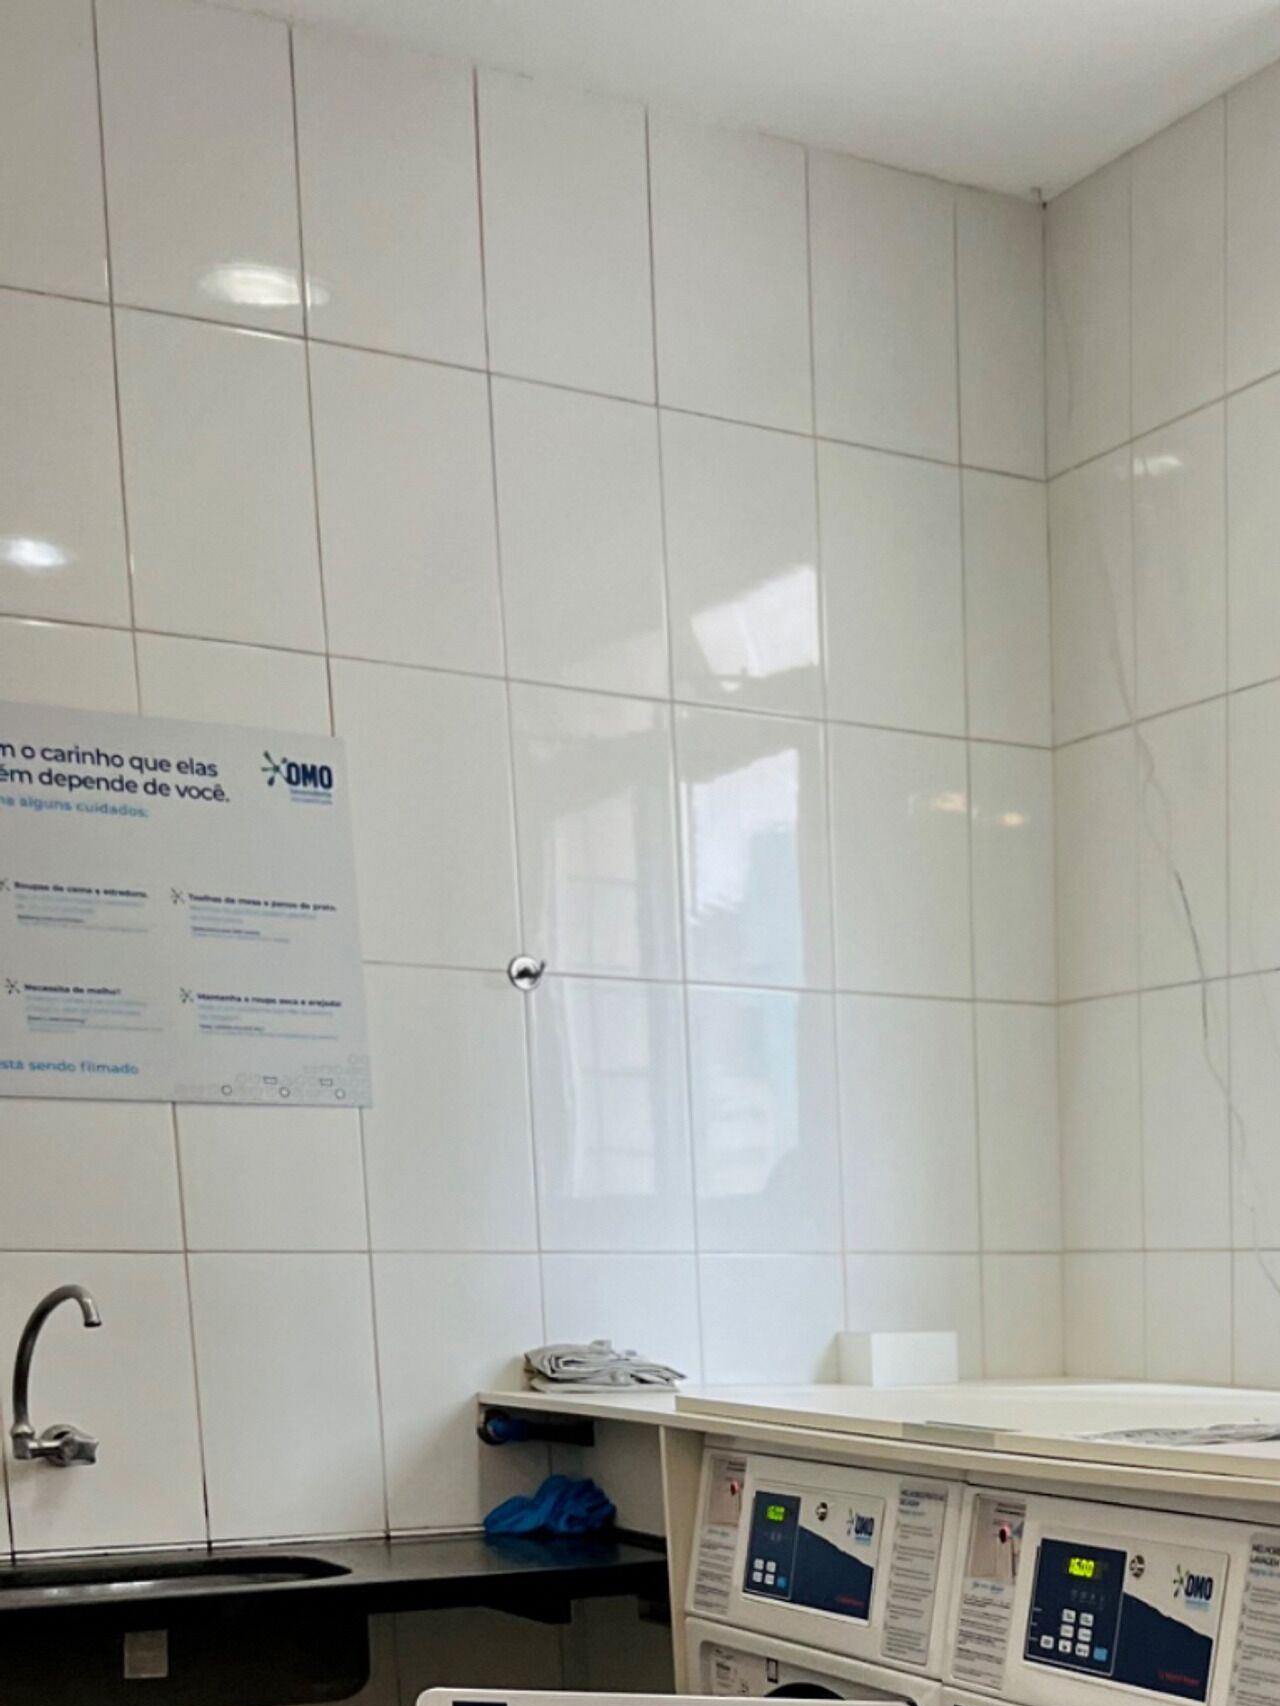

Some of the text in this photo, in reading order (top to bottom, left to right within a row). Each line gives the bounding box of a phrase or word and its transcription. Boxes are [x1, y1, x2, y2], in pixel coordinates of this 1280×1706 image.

[21, 745, 35, 759] o
[40, 746, 125, 768] carinho
[129, 754, 171, 774] que
[176, 757, 218, 777] elas
[38, 768, 138, 792] depende
[143, 778, 171, 797] de
[175, 784, 230, 803] você.
[287, 762, 333, 789] OMO
[29, 1061, 76, 1072] sendo
[81, 1061, 139, 1074] filmado
[1184, 1574, 1213, 1601] OMO
